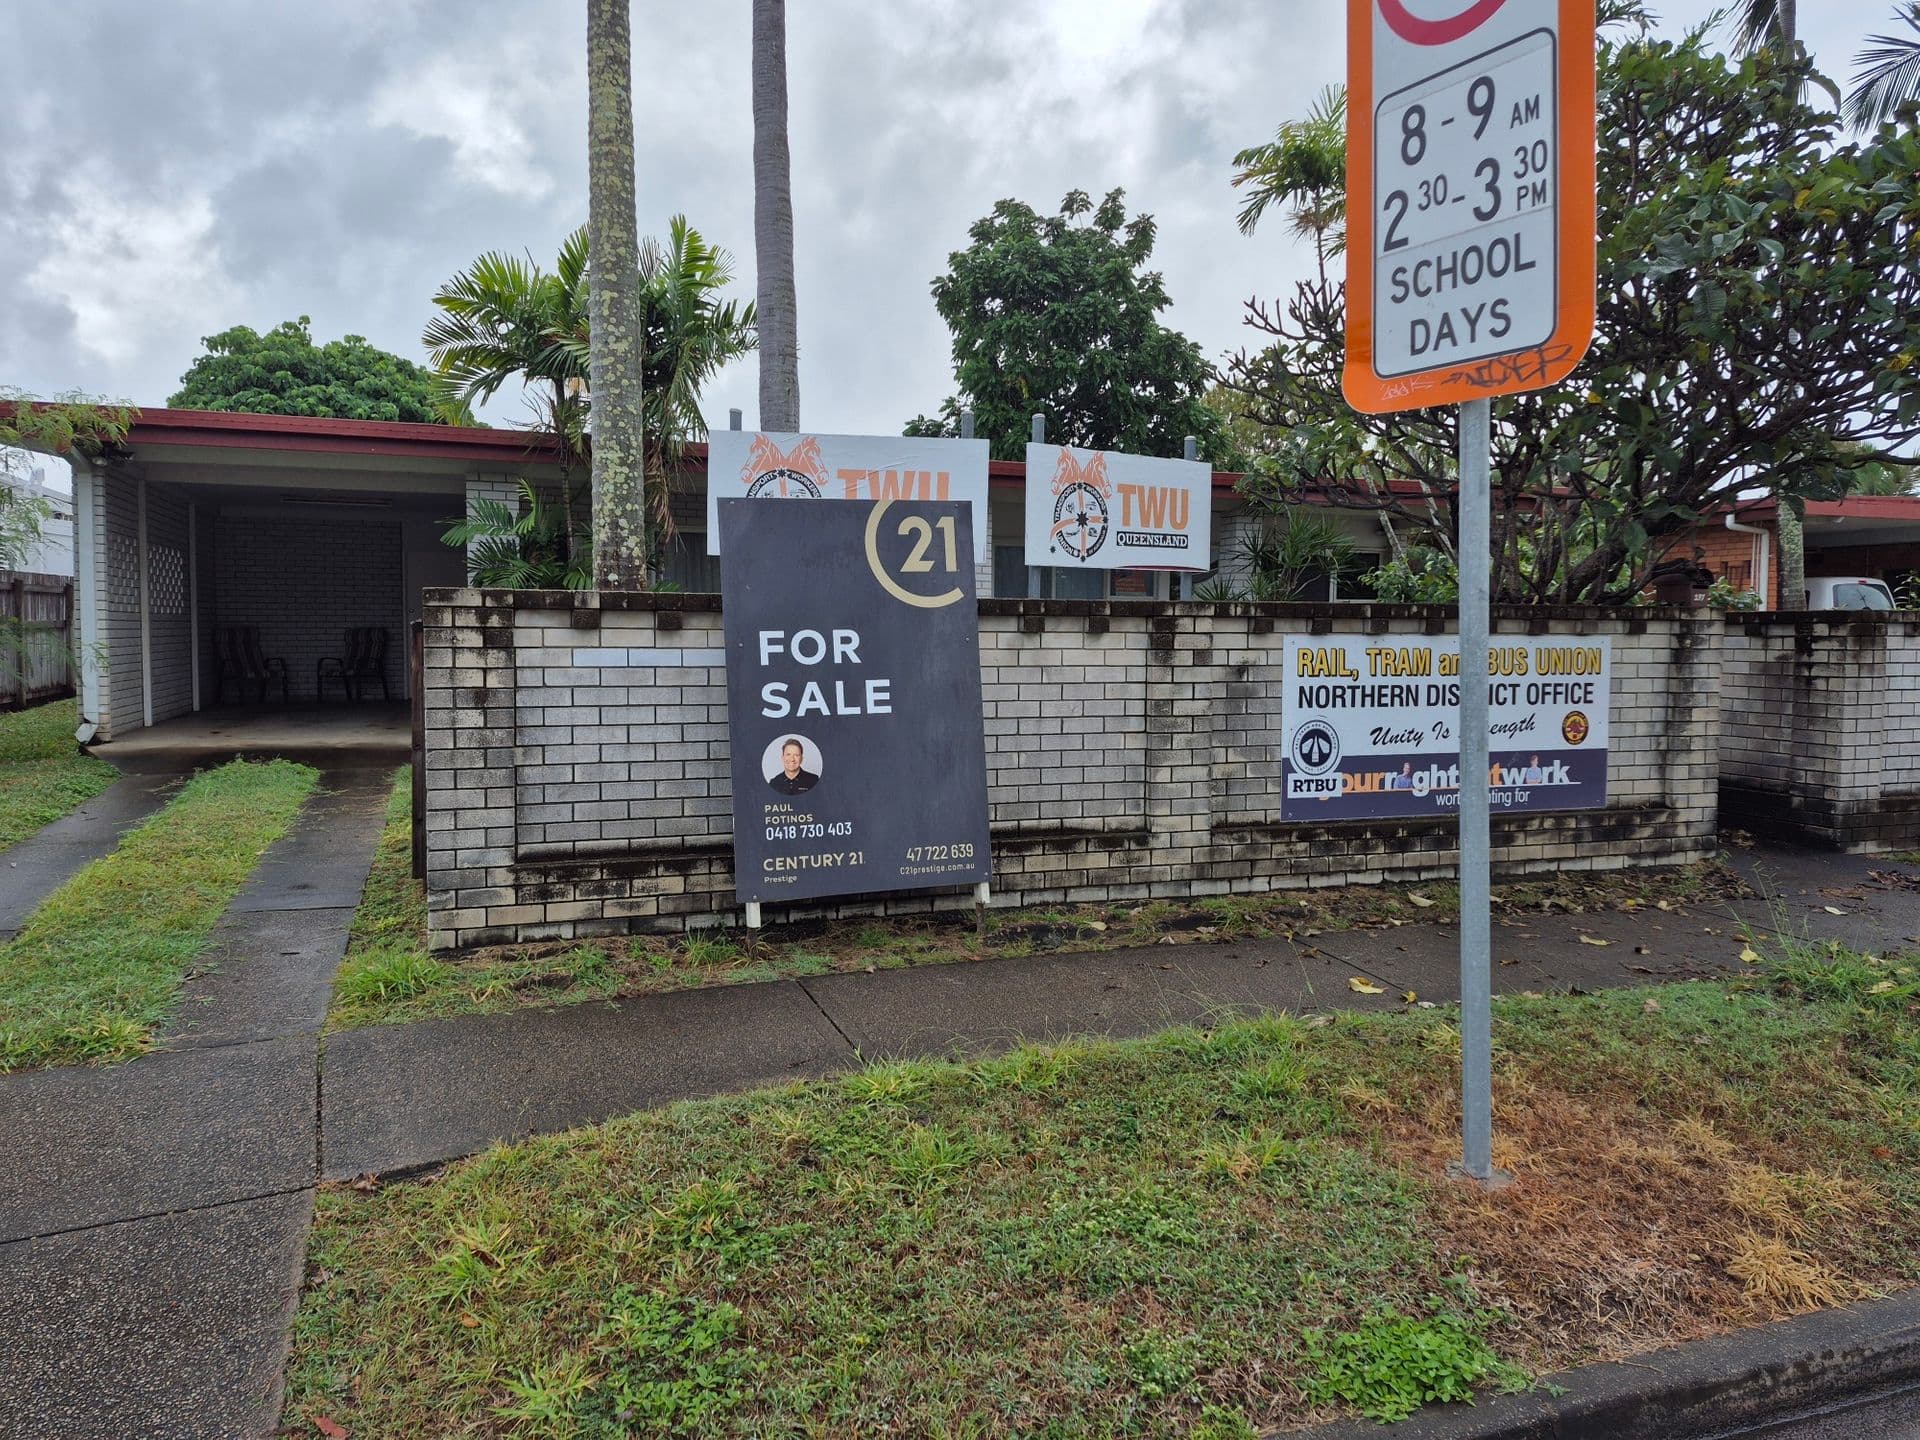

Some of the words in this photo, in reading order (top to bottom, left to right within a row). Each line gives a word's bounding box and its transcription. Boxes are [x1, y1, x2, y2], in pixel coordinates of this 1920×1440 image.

[1510, 95, 1540, 129] AM
[1516, 179, 1548, 211] PM
[1390, 232, 1536, 304] SCHOOL
[1410, 298, 1511, 356] DAYS
[1117, 483, 1190, 530] TWU
[1117, 532, 1188, 547] QUEENSLAND
[759, 629, 862, 666] FOR
[1297, 647, 1359, 681] RAIL,
[1365, 647, 1432, 677] TRAM
[1438, 653, 1461, 677] an
[1535, 646, 1602, 676] UNION
[761, 679, 892, 718] SALE
[1298, 684, 1419, 708] NORTHERN
[1426, 683, 1520, 706] DISICT
[1526, 682, 1594, 705] OFFICE
[1370, 726, 1424, 747] Unity
[1432, 721, 1451, 740] Is
[1293, 779, 1337, 792] RTBU
[1515, 788, 1530, 803] for
[764, 803, 794, 813] PAUL
[765, 814, 813, 825] FOTINOS
[766, 825, 796, 840] 0418
[800, 823, 824, 838] 730
[828, 821, 852, 836] 403
[763, 853, 844, 871] CENTURY
[849, 851, 864, 865] 21
[906, 847, 922, 861] 47
[925, 845, 949, 861] 722
[951, 843, 974, 859] 639
[764, 874, 798, 884] Prestige
